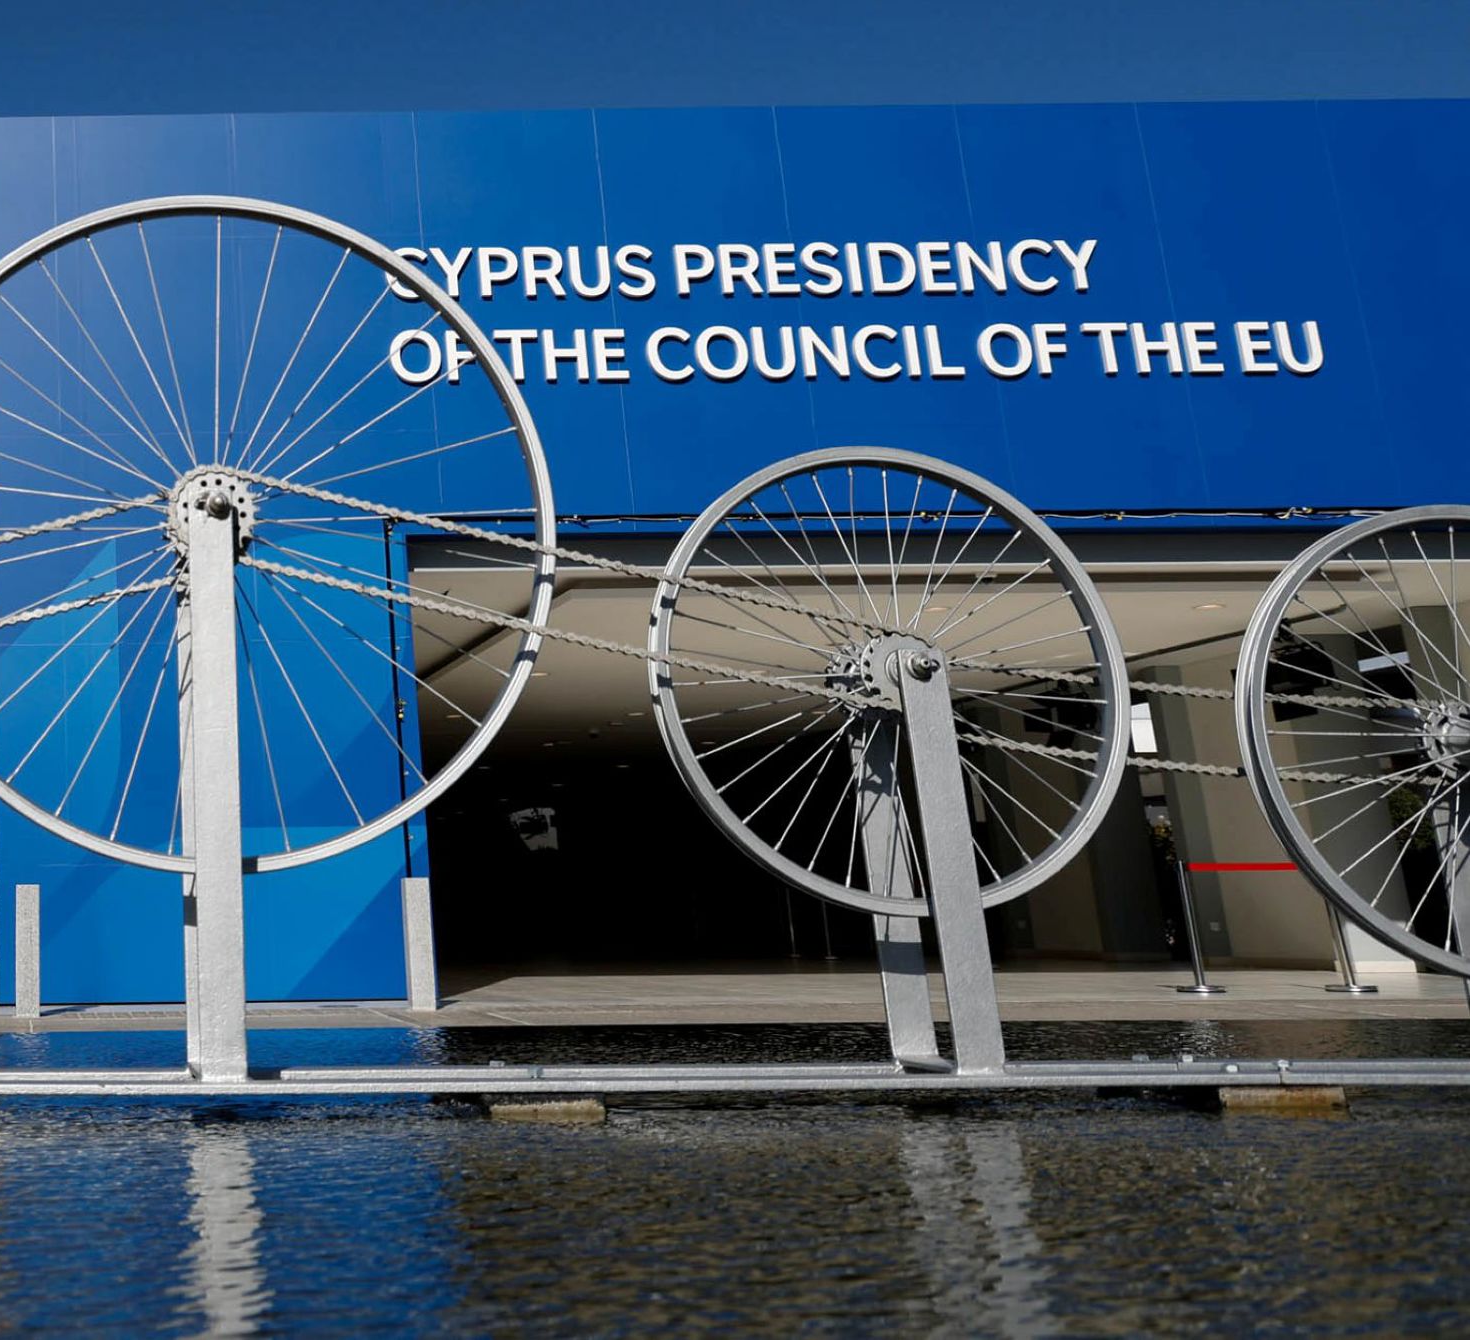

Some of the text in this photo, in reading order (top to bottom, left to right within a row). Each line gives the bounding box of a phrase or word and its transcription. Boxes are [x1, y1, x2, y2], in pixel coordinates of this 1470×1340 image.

[385, 238, 1098, 299] CYPRUS PRESIDENCY
[389, 319, 1325, 383] OF THE COUNCIL OF THE EU
